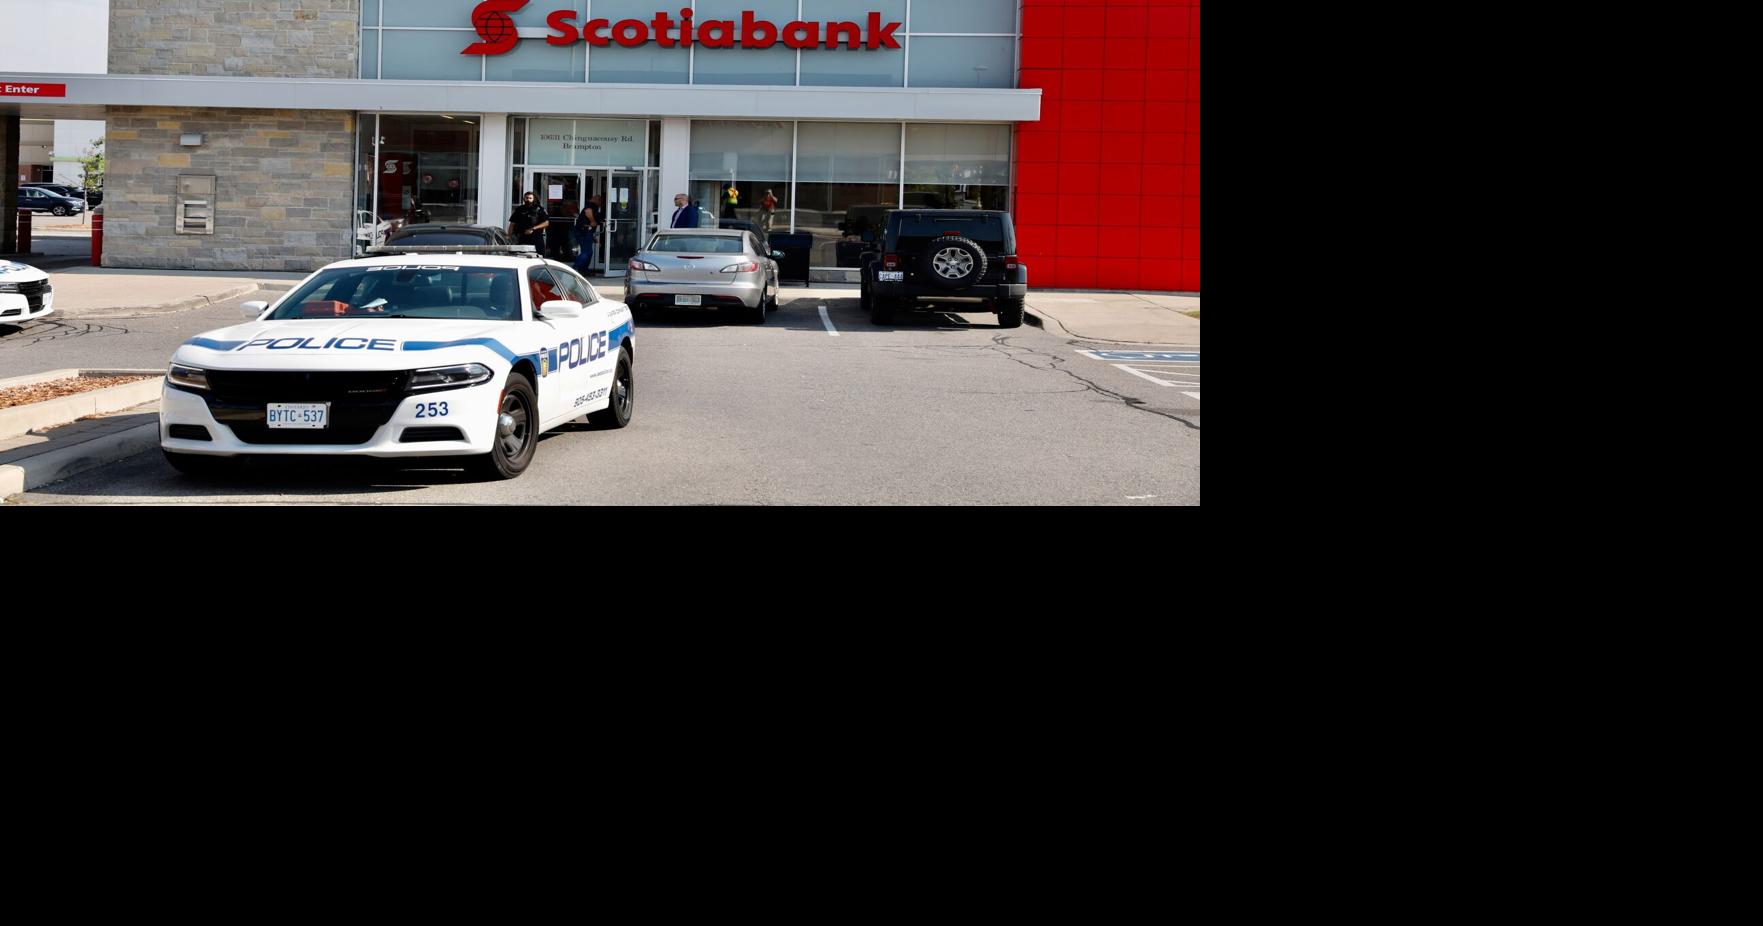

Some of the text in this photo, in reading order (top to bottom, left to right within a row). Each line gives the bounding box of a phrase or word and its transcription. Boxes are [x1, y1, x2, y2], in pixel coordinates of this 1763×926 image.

[546, 8, 902, 50] Scotiabank
[5, 85, 40, 94] Enter
[236, 337, 397, 351] POLICE
[559, 330, 607, 372] POLICE
[415, 402, 449, 418] 253
